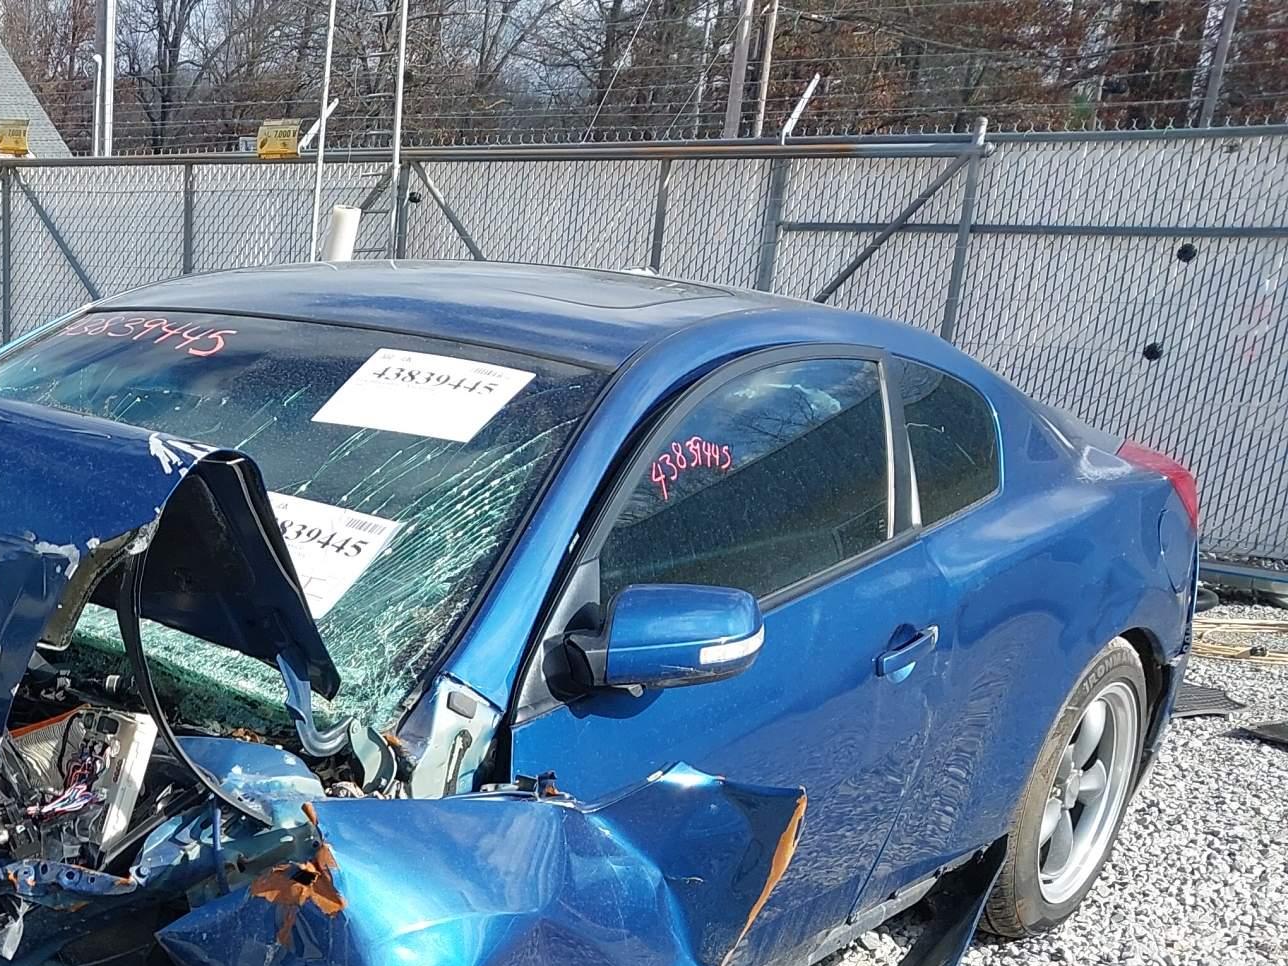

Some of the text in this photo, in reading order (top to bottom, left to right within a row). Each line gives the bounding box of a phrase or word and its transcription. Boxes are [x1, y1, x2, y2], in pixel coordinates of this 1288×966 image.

[372, 366, 500, 395] 43839445
[651, 436, 732, 501] 43839445
[279, 519, 369, 557] 839445
